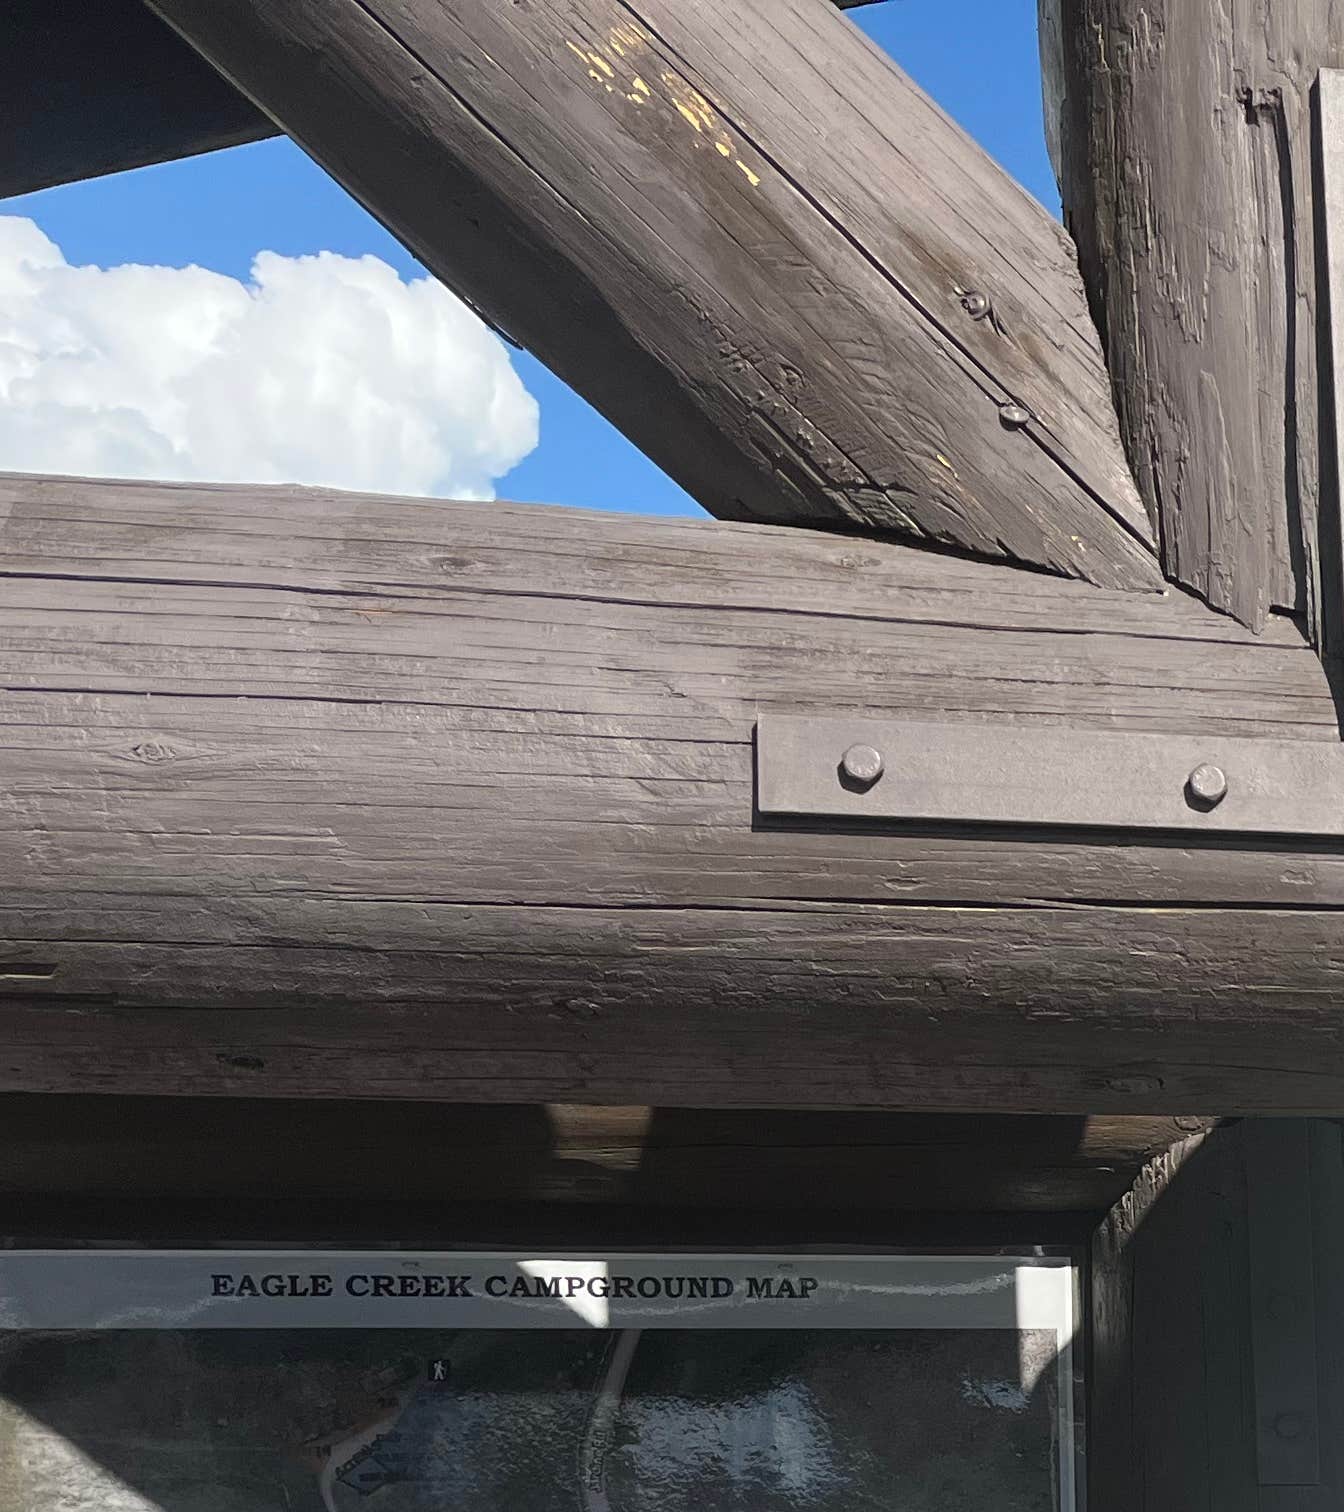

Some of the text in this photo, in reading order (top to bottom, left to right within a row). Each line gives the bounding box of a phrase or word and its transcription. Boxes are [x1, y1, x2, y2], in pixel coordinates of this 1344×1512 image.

[211, 1275, 818, 1300] EAGLE CREEK CAMPGROUND MAP
